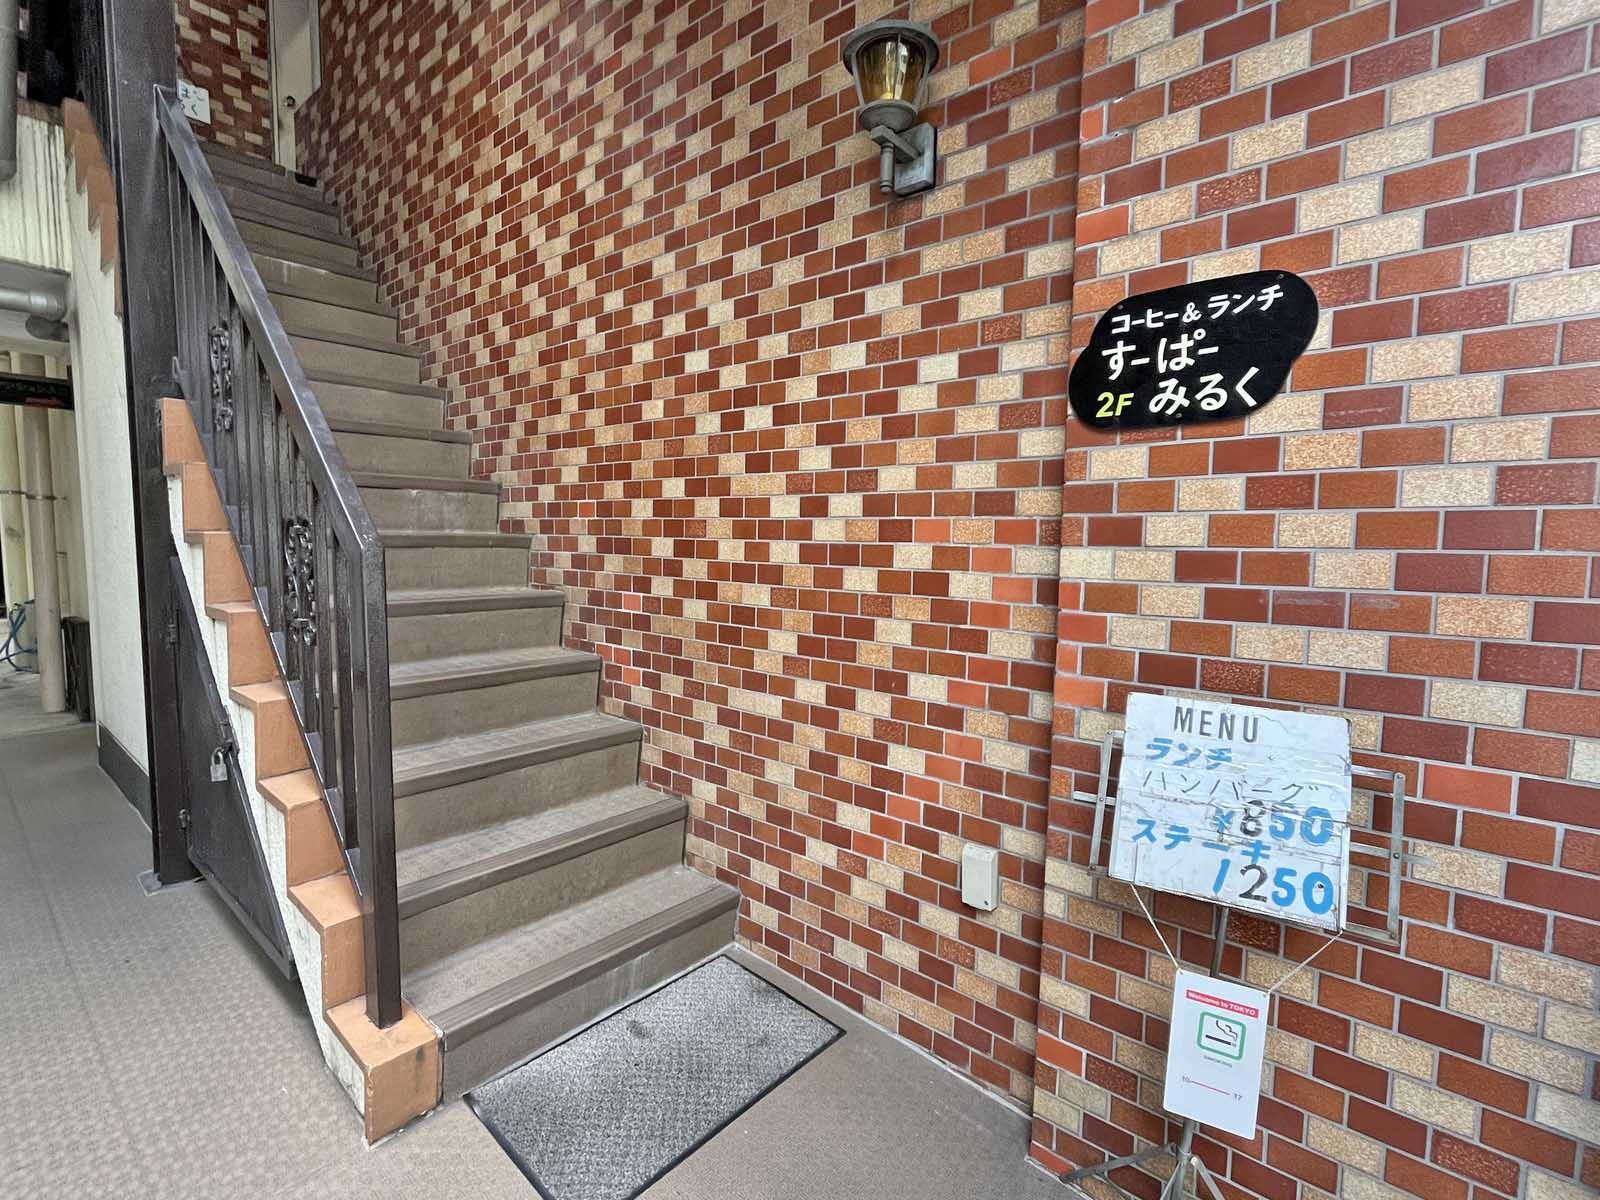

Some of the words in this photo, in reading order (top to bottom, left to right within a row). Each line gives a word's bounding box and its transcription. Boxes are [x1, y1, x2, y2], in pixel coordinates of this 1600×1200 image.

[1101, 328, 1219, 381] すーぱー
[1095, 391, 1134, 418] 2F
[1149, 366, 1260, 416] みるく
[1173, 706, 1259, 743] MENU
[1145, 737, 1233, 770] ランチ
[1143, 771, 1320, 802] ハンバーグ
[1132, 818, 1272, 865] ステーキ
[1212, 858, 1334, 915] 1250
[1229, 1003, 1257, 1016] TOKYO
